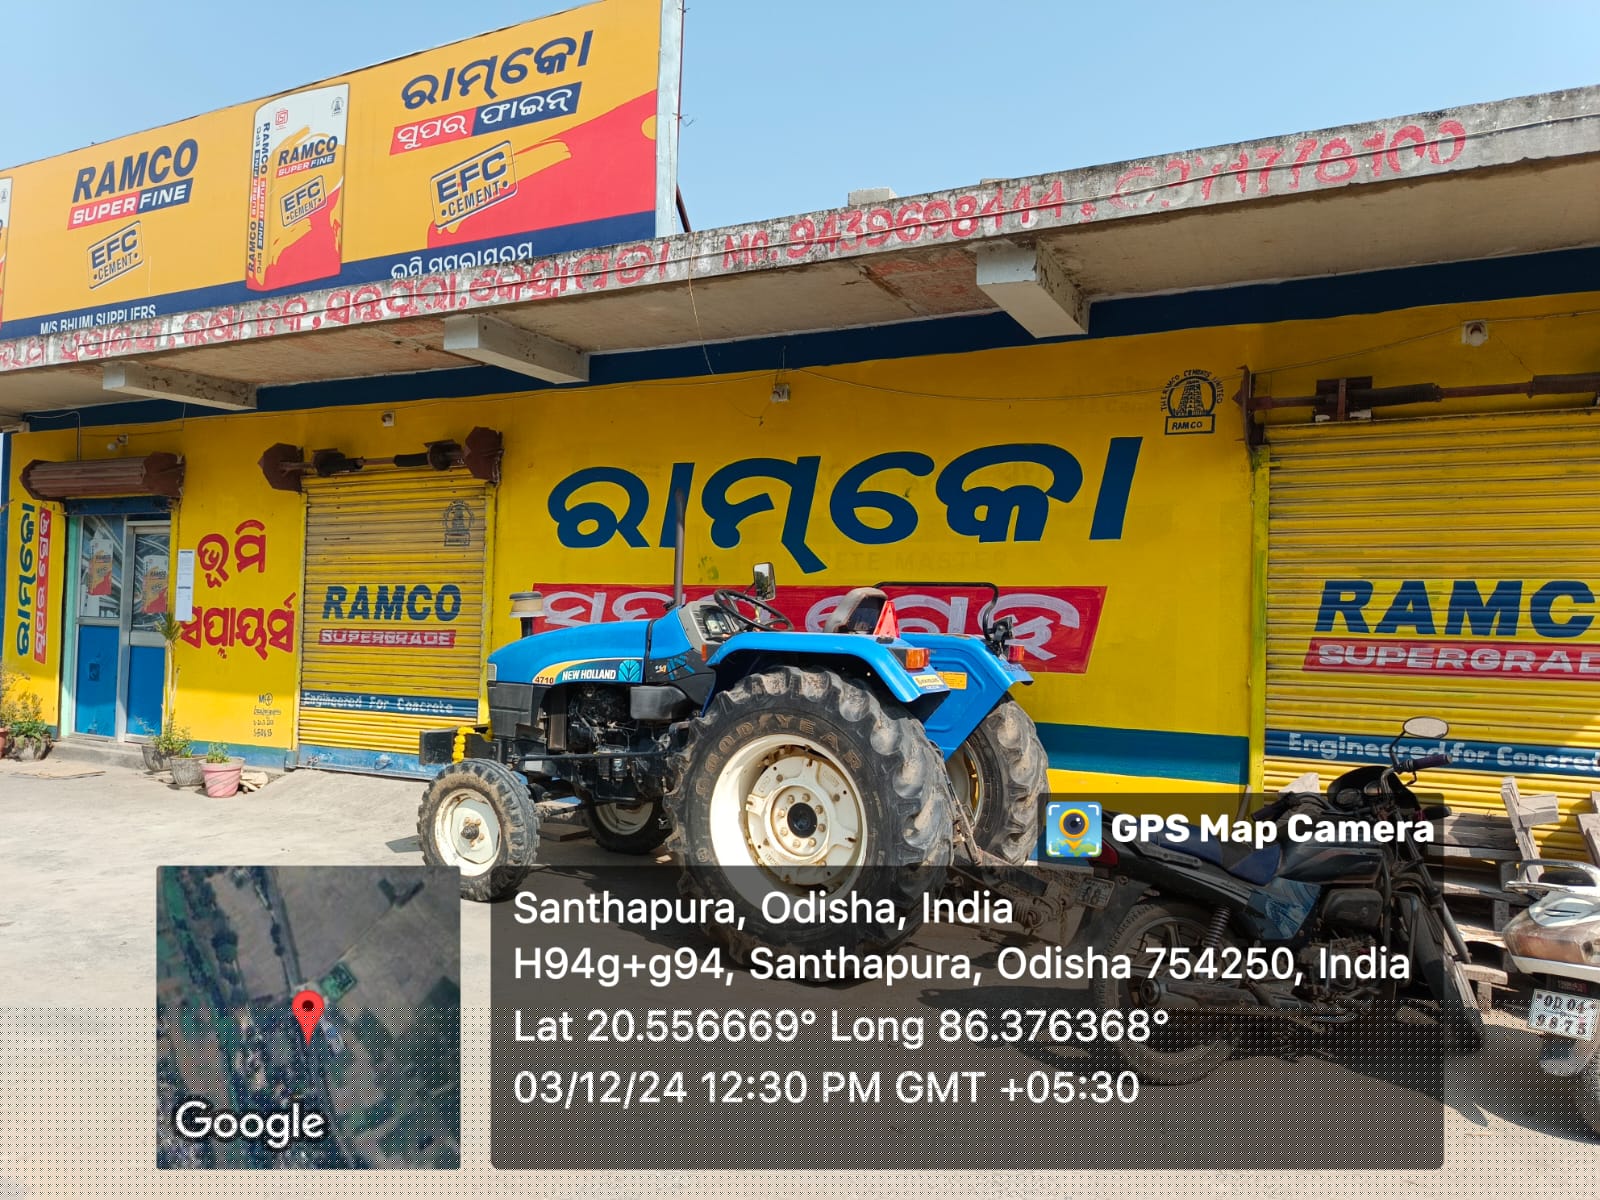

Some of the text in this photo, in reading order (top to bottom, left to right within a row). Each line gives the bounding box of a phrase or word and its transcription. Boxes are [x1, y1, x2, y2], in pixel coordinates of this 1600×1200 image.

[260, 122, 271, 175] RAMCO
[278, 135, 339, 166] RAMCO
[72, 138, 199, 204] RAMCO
[277, 155, 334, 177] SUPER FINE
[436, 151, 507, 204] EFC
[72, 183, 188, 225] SUPER FINE
[283, 181, 321, 213] EFC
[289, 199, 317, 221] CEMENT
[447, 180, 500, 217] CEMENT
[91, 229, 138, 269] EFC
[248, 221, 257, 273] RAMCO
[257, 221, 265, 249] FINE
[97, 252, 134, 281] CEMENT
[1172, 421, 1203, 431] RAMCO
[322, 583, 462, 622] RAMCO
[1314, 579, 1596, 638] RAMC
[320, 629, 451, 647] SUPERGRADE
[534, 669, 617, 684] 4710 NEW HOLLAND
[368, 696, 389, 710] For
[1451, 741, 1491, 764] for
